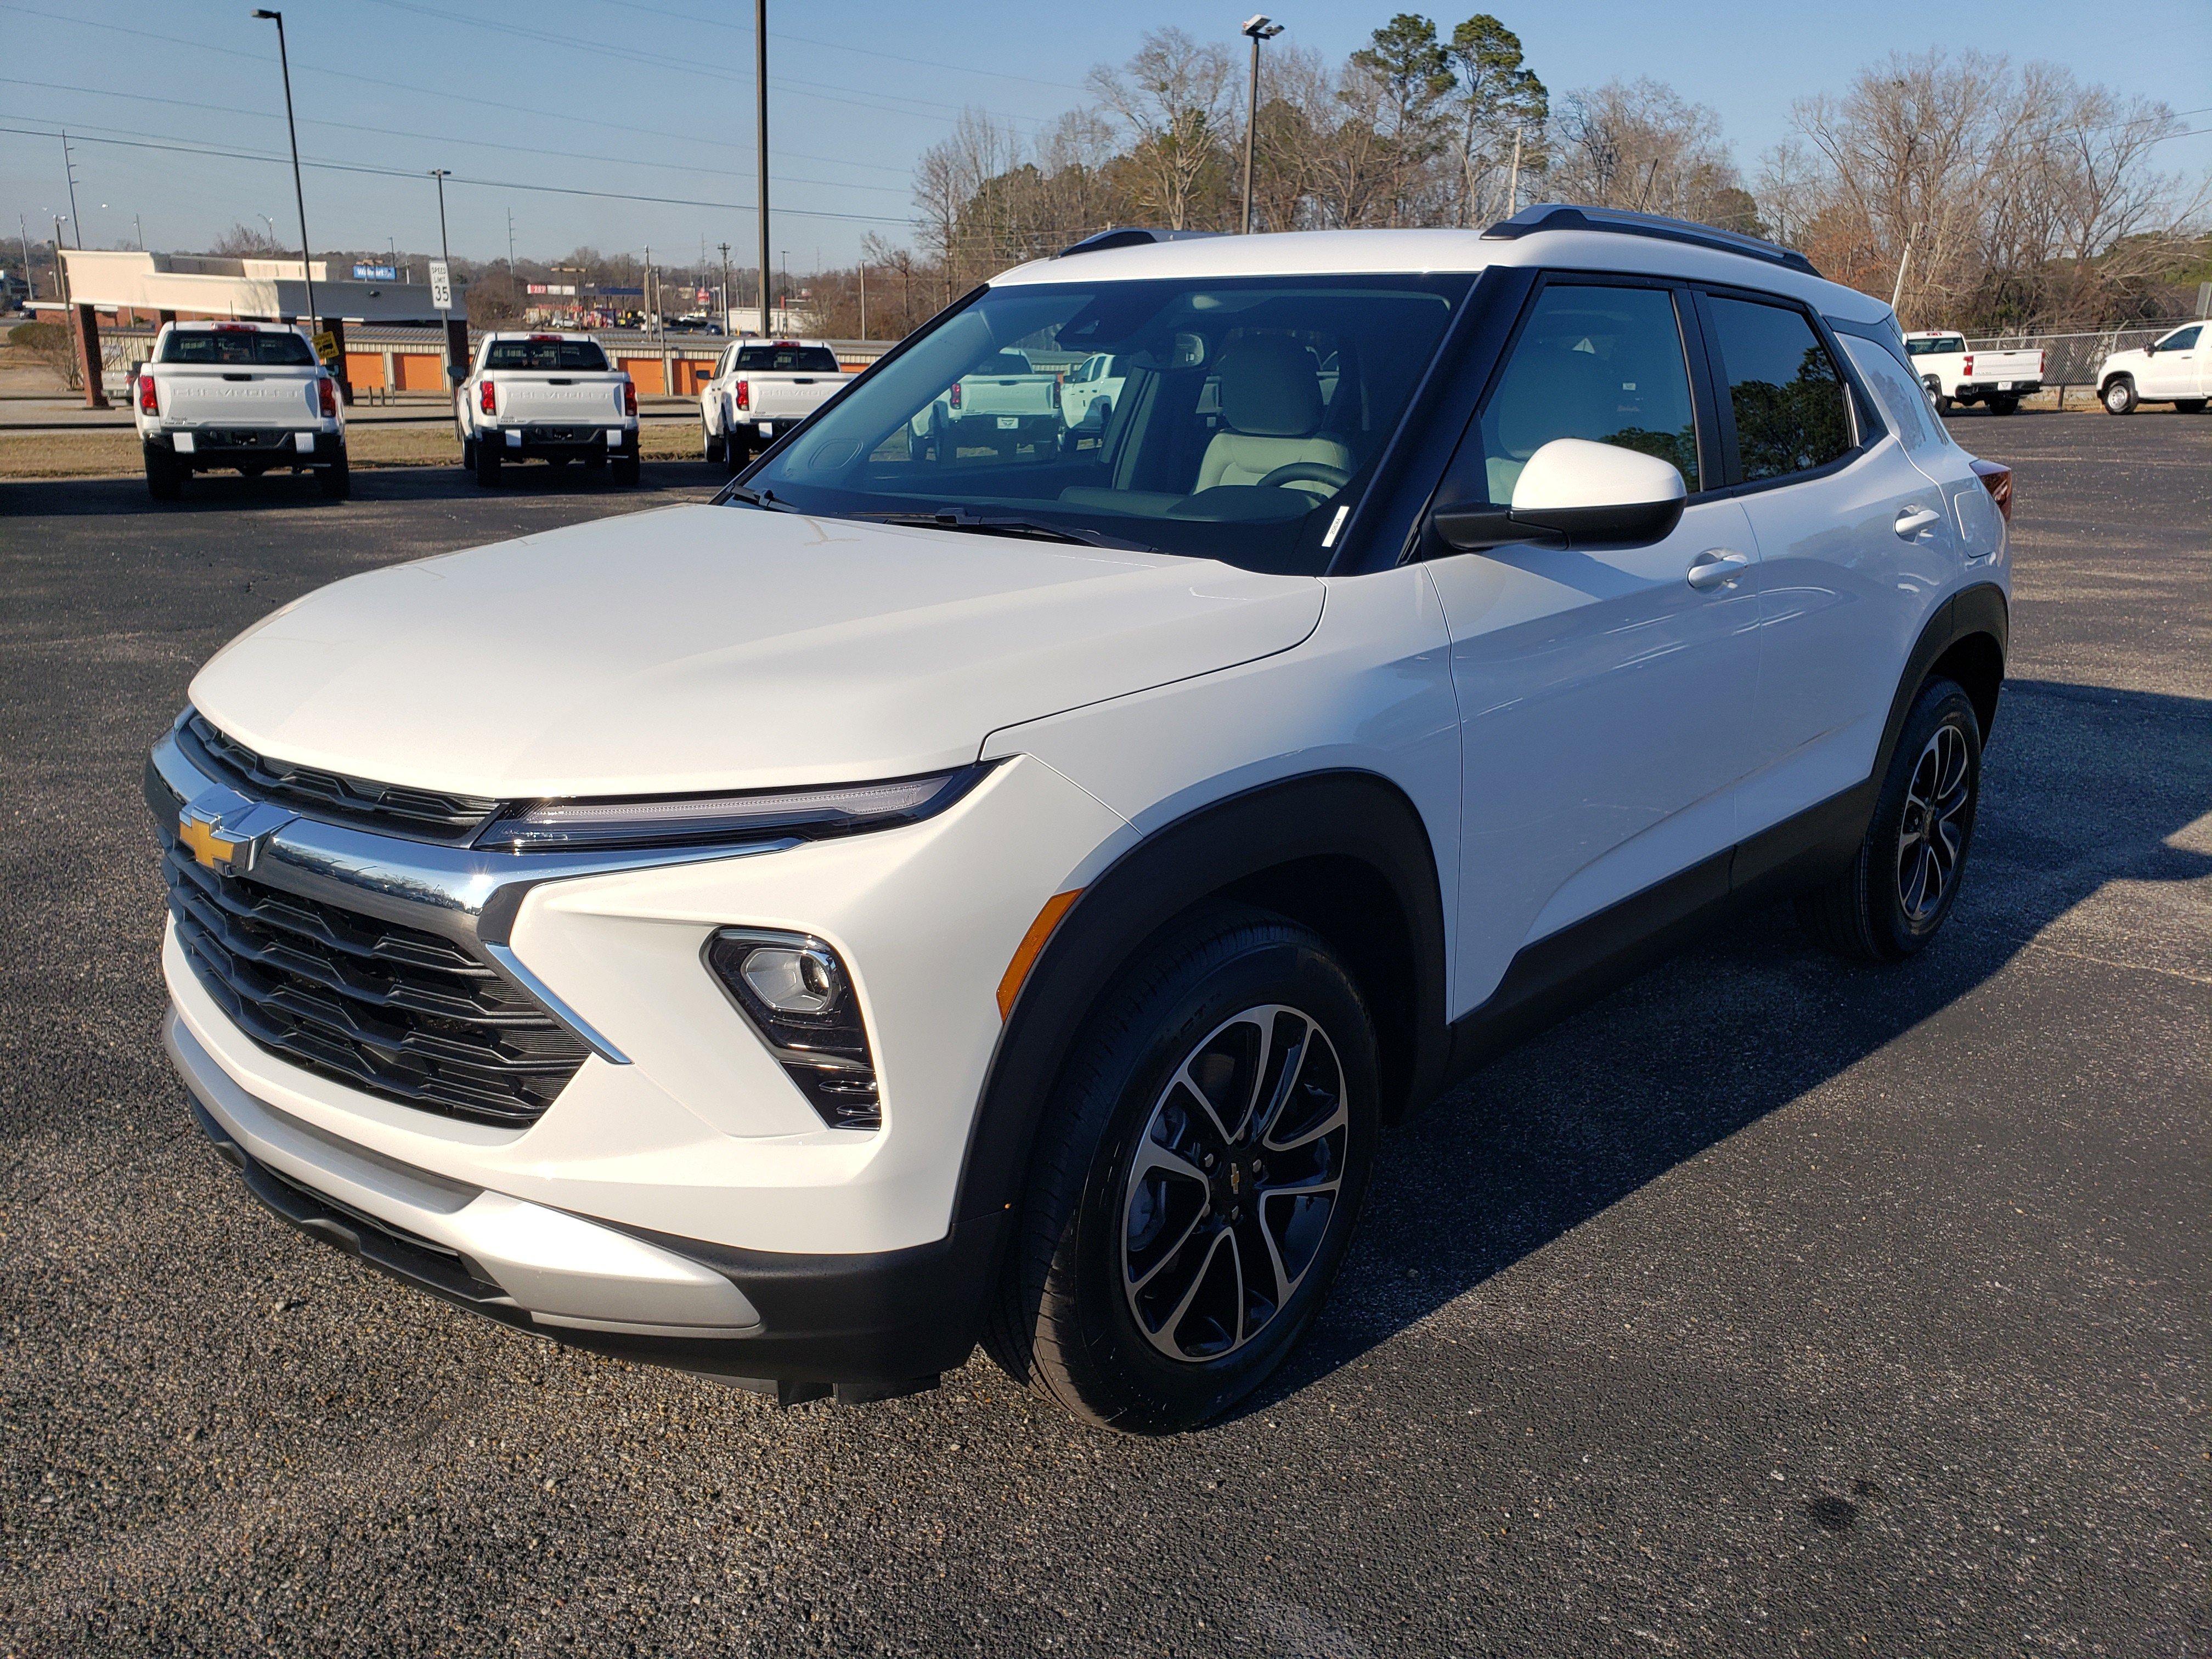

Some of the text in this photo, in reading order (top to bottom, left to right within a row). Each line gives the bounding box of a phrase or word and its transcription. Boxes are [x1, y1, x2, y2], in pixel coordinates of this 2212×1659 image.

[435, 286, 449, 301] 35
[173, 388, 302, 398] CHEVROLET
[509, 391, 611, 399] CHEVROLET
